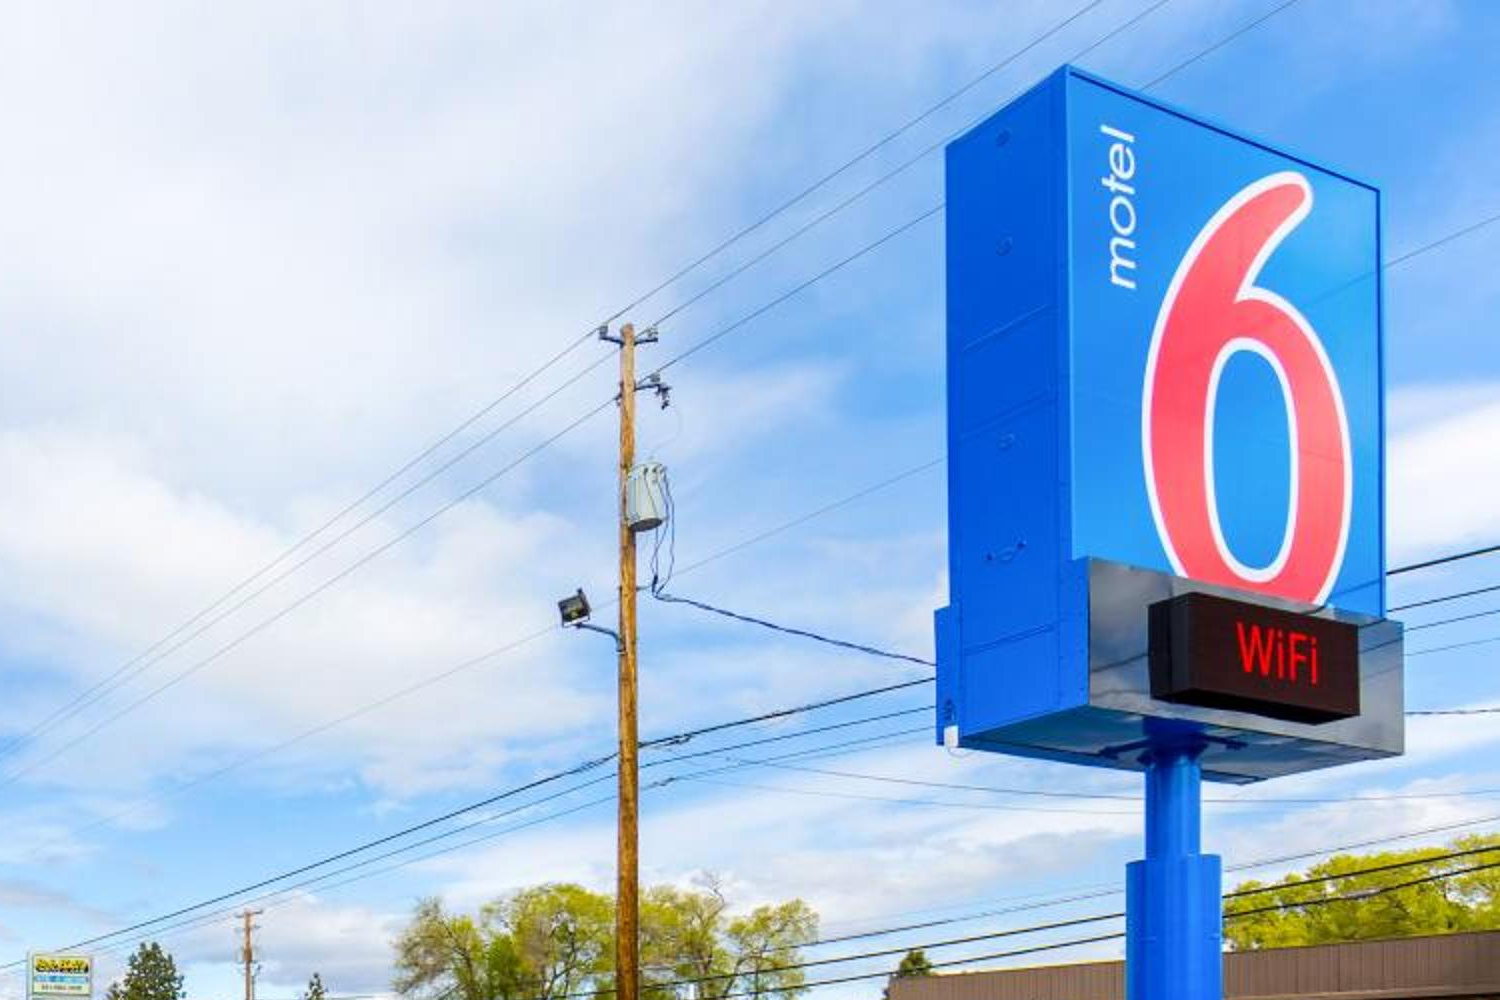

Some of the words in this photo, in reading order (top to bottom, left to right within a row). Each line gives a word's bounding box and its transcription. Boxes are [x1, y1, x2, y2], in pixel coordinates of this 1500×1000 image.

[1100, 124, 1137, 290] motel
[1141, 170, 1353, 607] 6
[1236, 620, 1318, 686] WiFi
